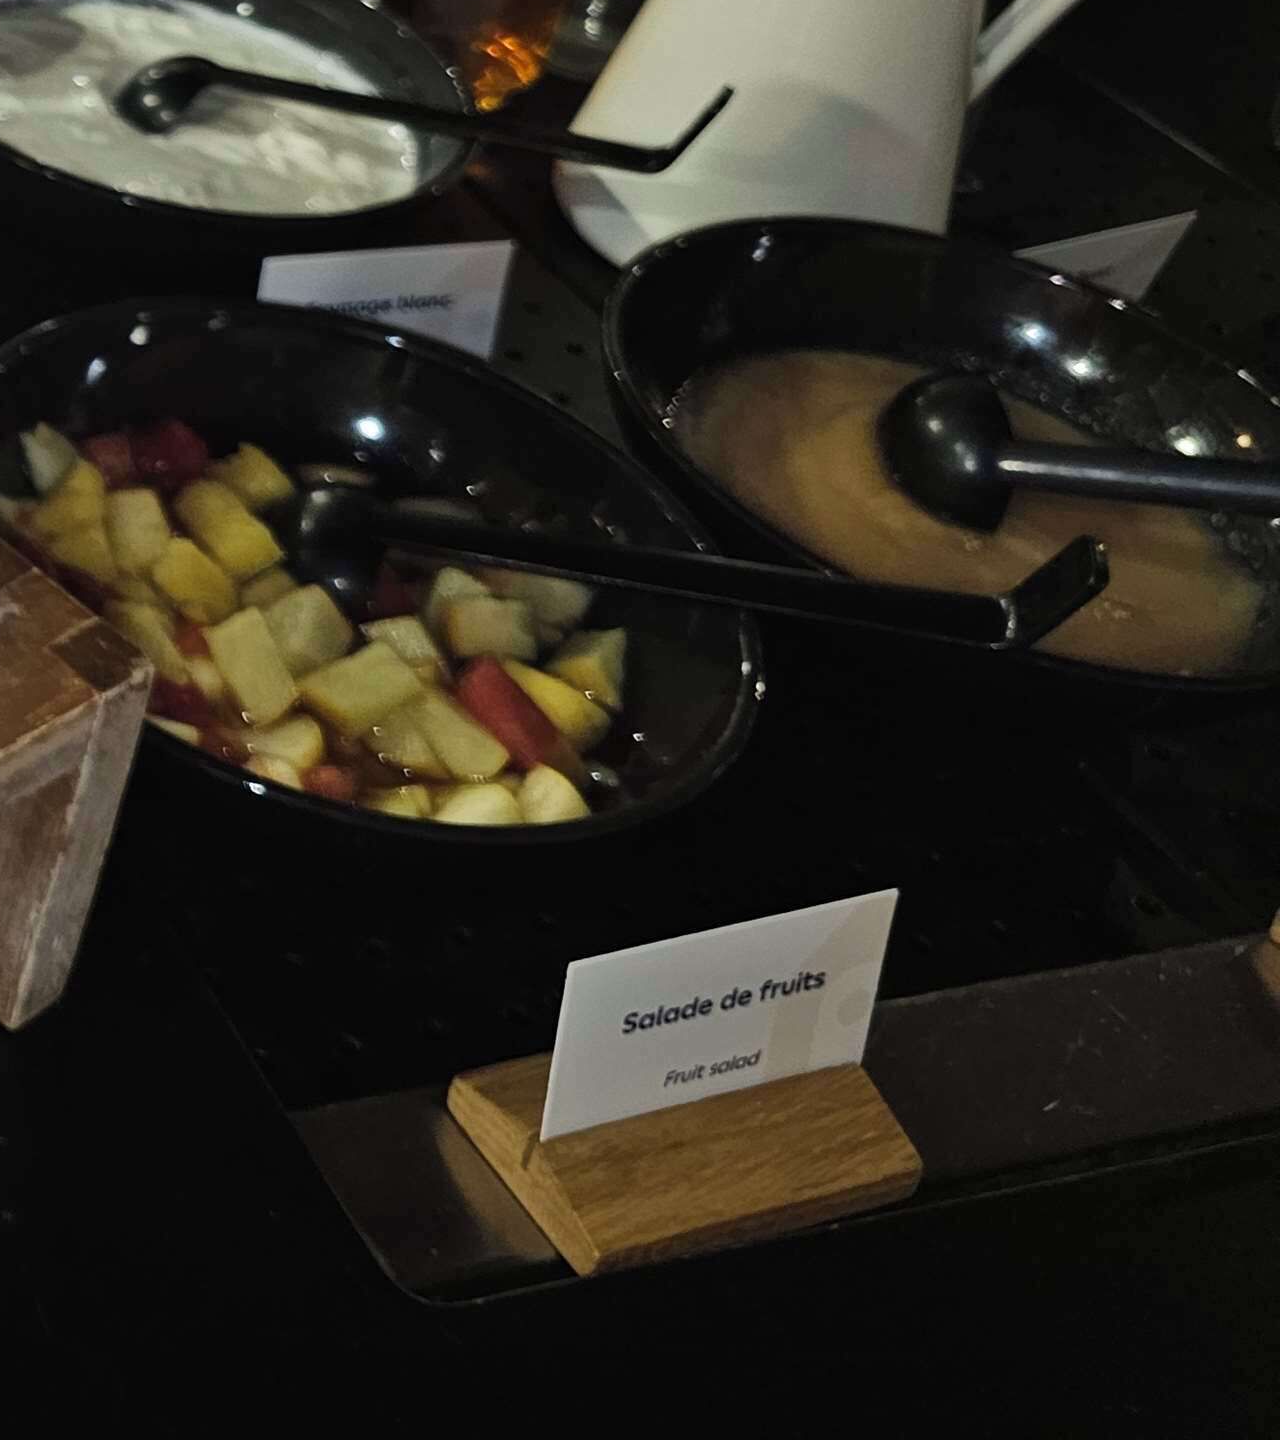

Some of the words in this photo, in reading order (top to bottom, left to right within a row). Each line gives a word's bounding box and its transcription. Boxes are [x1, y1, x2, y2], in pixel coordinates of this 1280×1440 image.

[621, 996, 714, 1035] Salade
[719, 986, 753, 1012] de
[759, 971, 827, 1002] fruits
[663, 1063, 706, 1088] Fruit
[708, 1049, 762, 1077] salad
